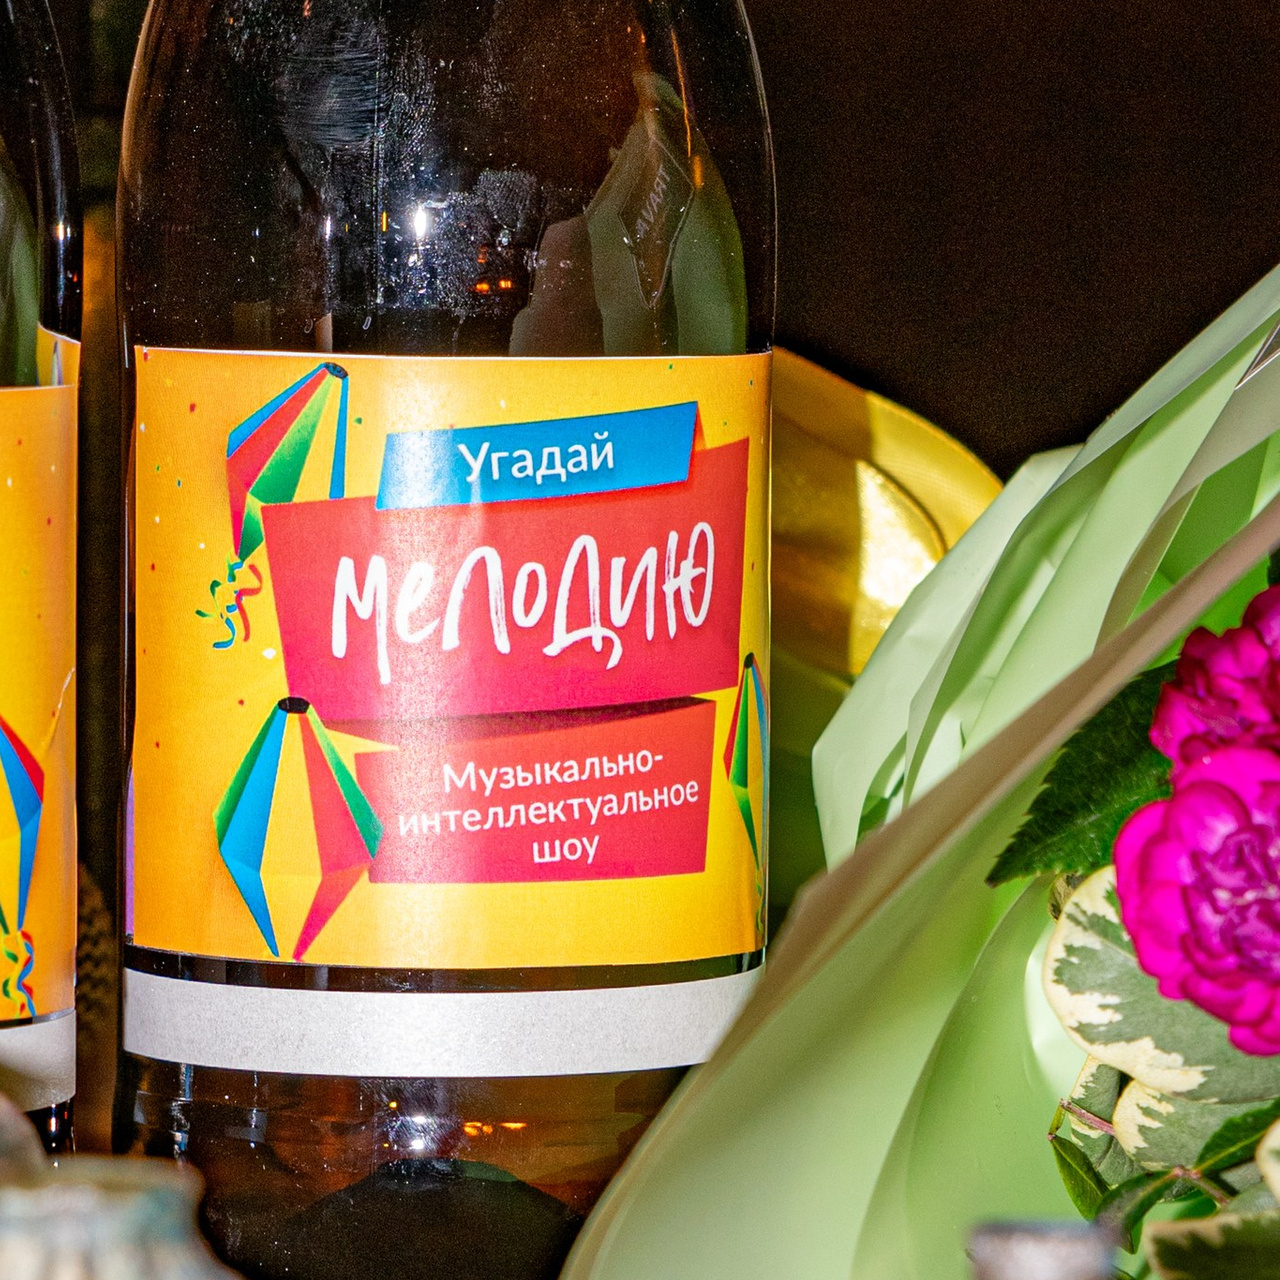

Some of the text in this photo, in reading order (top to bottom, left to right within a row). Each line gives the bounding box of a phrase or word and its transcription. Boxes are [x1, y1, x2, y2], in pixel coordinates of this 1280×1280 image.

[458, 432, 615, 484] Угадай
[442, 745, 664, 795] Музыкально-
[398, 780, 700, 837] интеллектуальное
[532, 833, 600, 865] шоу
